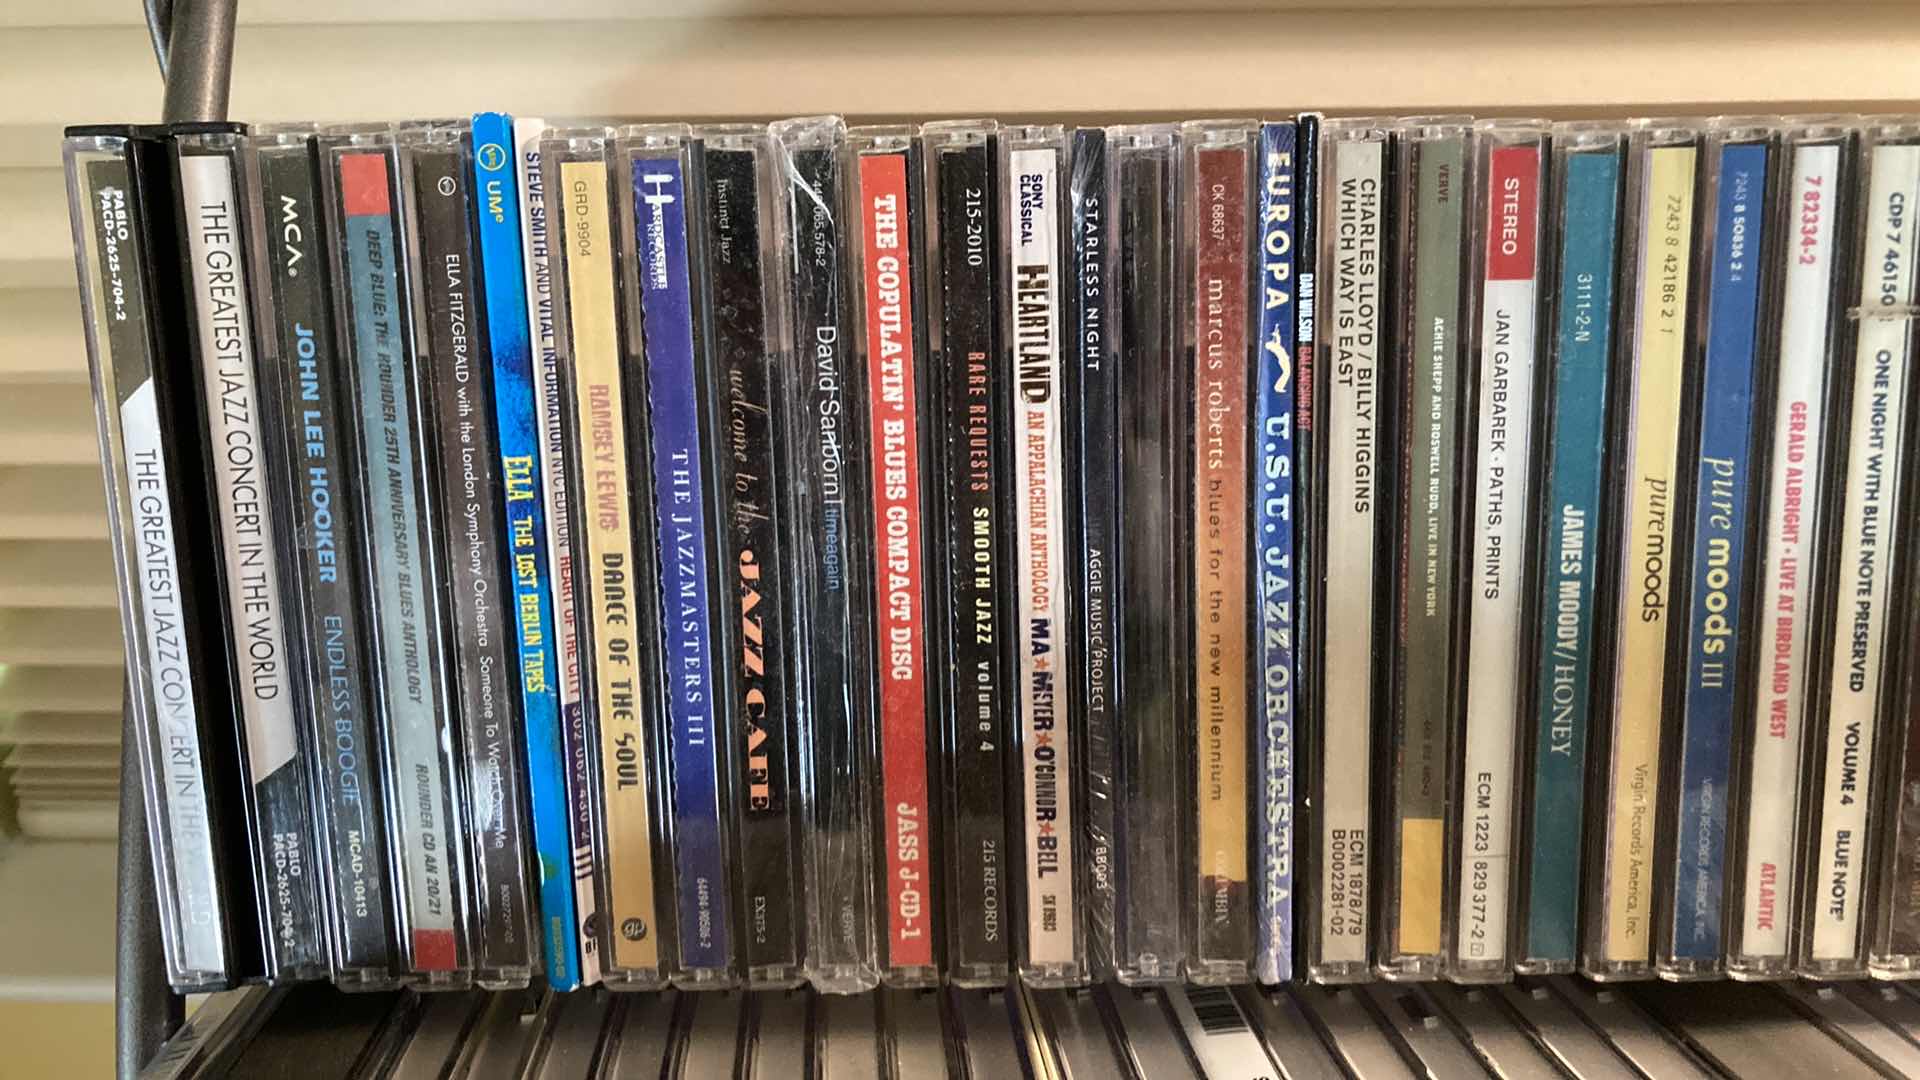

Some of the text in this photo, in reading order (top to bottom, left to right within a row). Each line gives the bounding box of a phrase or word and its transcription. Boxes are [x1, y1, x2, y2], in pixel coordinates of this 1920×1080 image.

[101, 191, 126, 320] PACD-2625-704-2
[114, 190, 128, 240] PABLO
[647, 223, 660, 290] RECORDS
[815, 233, 827, 266] 578-2
[1020, 174, 1033, 246] CLASSICAL
[1032, 174, 1043, 209] SONY
[1266, 152, 1291, 309] EUROPA
[1338, 179, 1356, 387] WHICH WAY EAST
[1730, 217, 1745, 258] 50836
[526, 153, 574, 604] STEVE SMITH AND VITAL INFORMATION NYC HEART
[816, 326, 840, 495] David Sanborn
[1017, 265, 1051, 403] HEARTLAND
[1028, 411, 1046, 430] AN
[1298, 300, 1313, 405] WILSON BALANCING
[1355, 179, 1376, 513] CHARLES LLOYD BILLY HIGGINS
[1426, 164, 1449, 584] VERVE SHEPP ROSWELL LIVE NEW
[1560, 274, 1592, 575] 3111-2-N JAMES
[206, 250, 277, 700] GREATEST JAZZ CONCERT IN WORLD
[366, 230, 432, 828] DEEP BLUE: ROUNDER 25TH ANNIVERSARY BLUES ANTHOLOGY ROUNDER
[445, 254, 499, 737] ELLA FITZGERALD with London Symphony Orchestra Someone To
[573, 181, 636, 790] GRD-9904 RAMSEY DANCE SOUL
[716, 179, 770, 810] Instinct Jazz welcome the JAZZ CAFE
[1029, 434, 1048, 528] APPALACHIAN
[1085, 198, 1105, 712] STARLESS NIGHT AGGIE MUSIC PROJECT
[1208, 279, 1231, 802] marcus roberts blues new millennium
[1472, 177, 1520, 938] STEREO JAN GARBAREK PATHS, PRINTS ECM 1223 377-2
[1704, 457, 1736, 529] pure
[1834, 192, 1904, 868] CDP 46150 ONE NIGHT WITH BLUE PRESERVED VOLUME BLUE
[135, 449, 194, 796] THE GREATEST JAZZ IN
[295, 323, 359, 806] JOHN HOOKER ENDLESS BOOGIE
[503, 455, 544, 693] ELLA THE LOST BERLIN TAPES
[671, 449, 705, 746] THE JAZZMASTERS III
[874, 194, 920, 939] THE COPULATIN' BLUES COMPACT DISC J-CD-1
[966, 188, 998, 941] 215-2010 RARE REQUESTS SMOOTH JAZZ volume RECORDS
[1030, 532, 1050, 612] ANTHOLOGY
[1264, 546, 1291, 651] JAZZ
[1625, 195, 1681, 938] 7243 42186 Virgin Records America, Inc.
[1704, 538, 1734, 654] moods
[1758, 190, 1820, 931] 82334-2 GERALD ALBRIGHT LIVE BIRDLAND WEST ATLANTIC
[1701, 662, 1723, 688] III
[287, 832, 301, 876] PABLO
[1265, 664, 1291, 906] ORCHESTRA
[1330, 829, 1346, 936] B0002281-02
[1348, 830, 1363, 936] ECM 1878/79
[1698, 777, 1713, 813] VIRGIN
